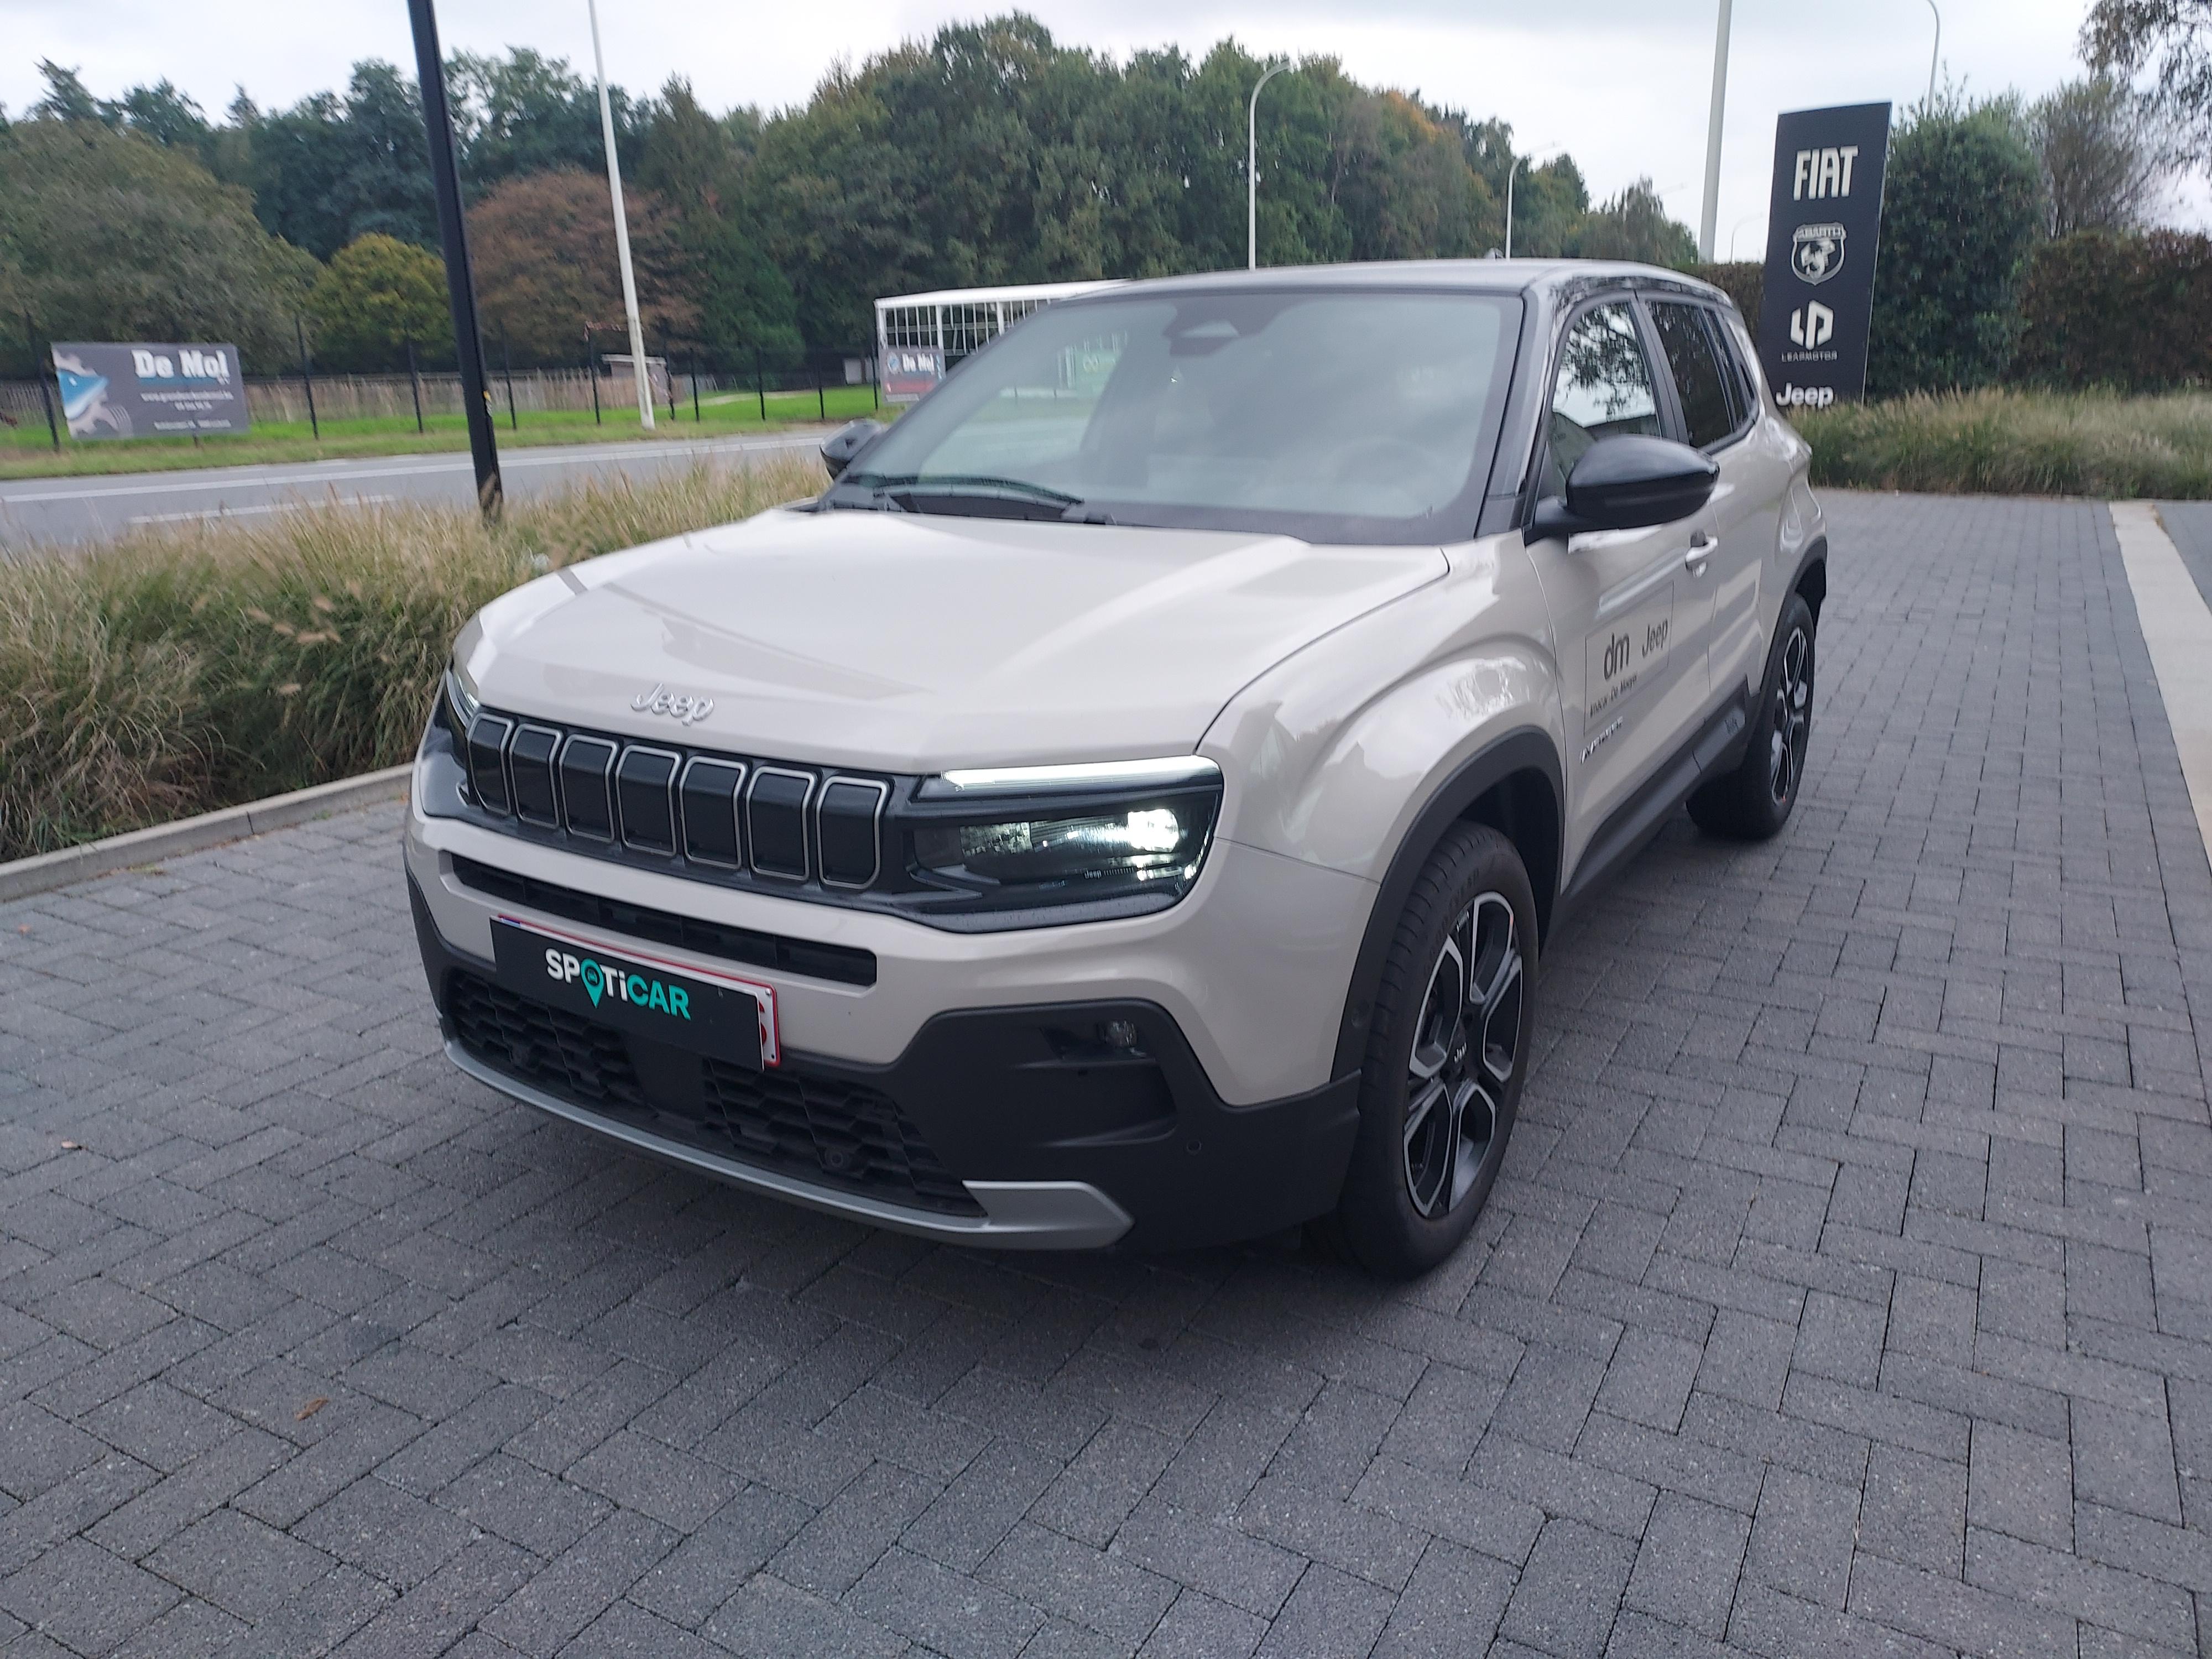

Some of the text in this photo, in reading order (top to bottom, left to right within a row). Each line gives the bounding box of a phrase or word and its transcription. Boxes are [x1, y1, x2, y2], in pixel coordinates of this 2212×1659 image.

[1794, 145, 1858, 201] FIAT
[132, 348, 231, 378] De Mol
[1781, 351, 1838, 362] LEAPMOTOR
[1776, 382, 1834, 409] Jeep
[1604, 618, 1668, 680] dm Jeep
[630, 683, 714, 726] Jeep
